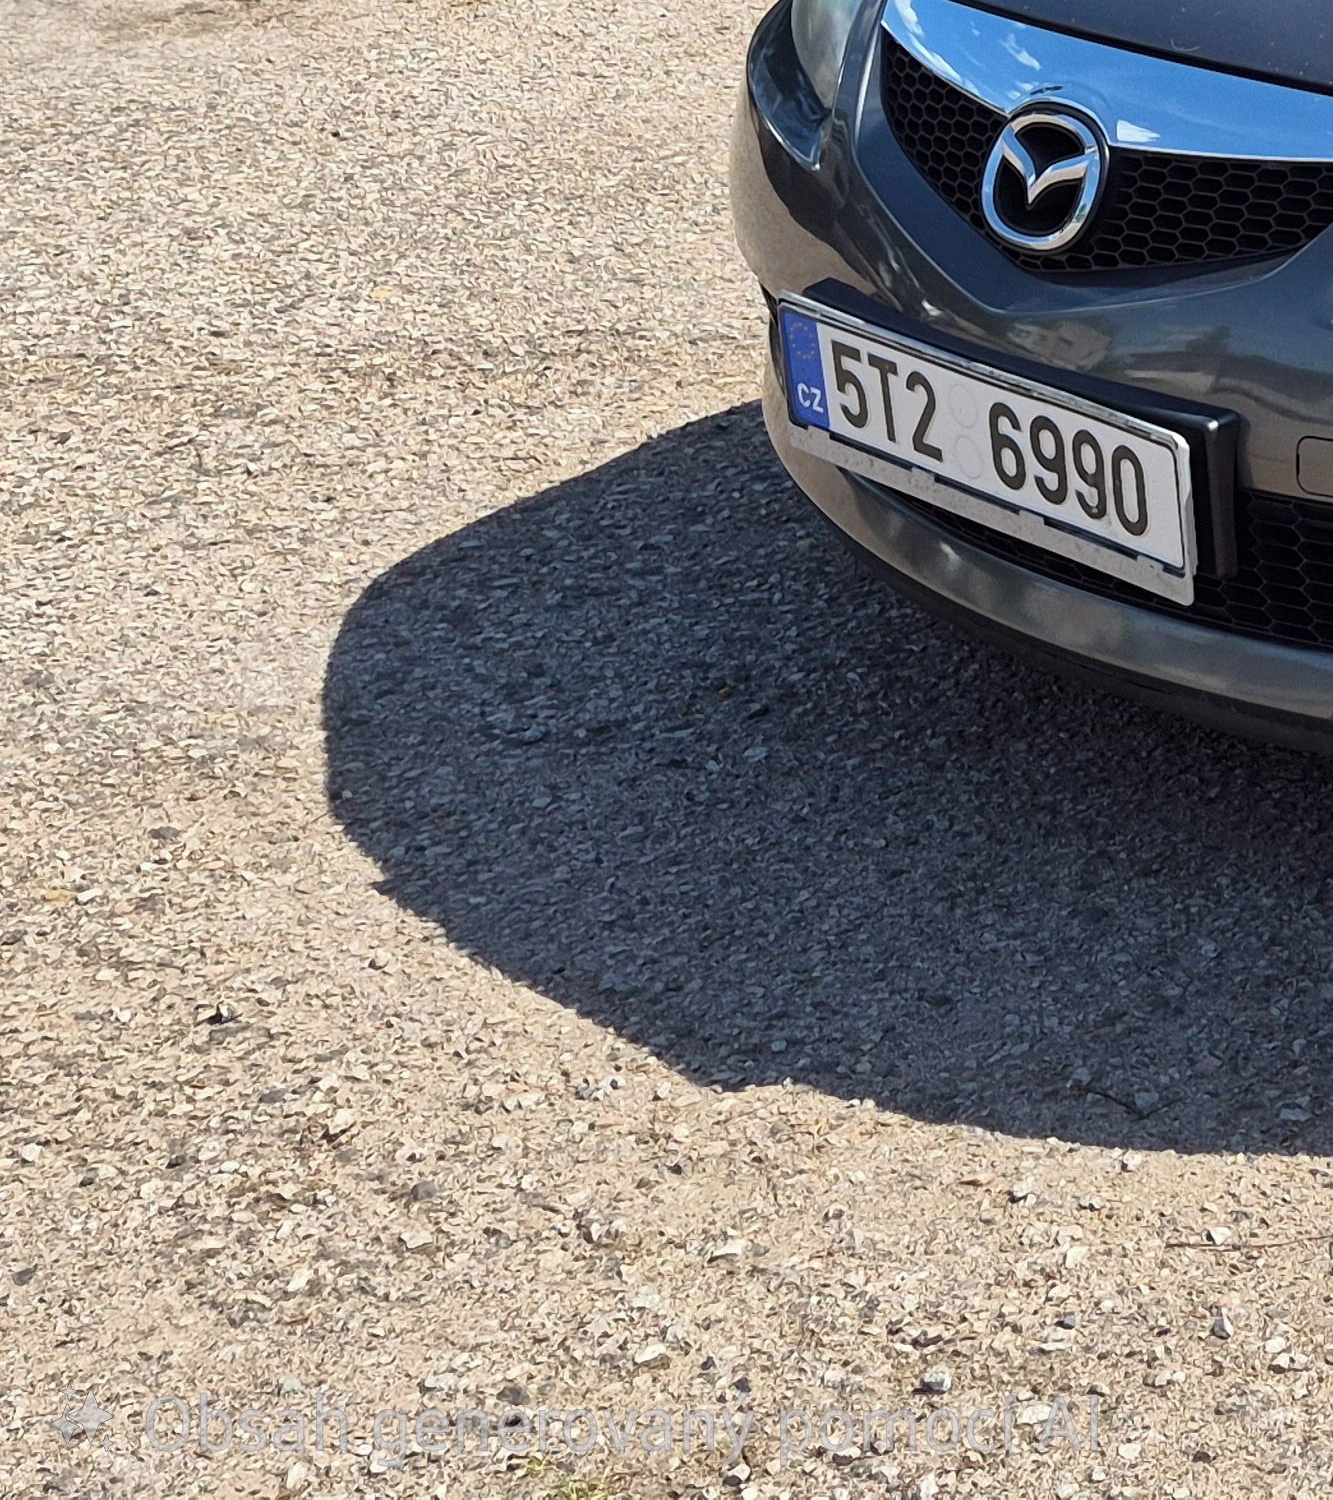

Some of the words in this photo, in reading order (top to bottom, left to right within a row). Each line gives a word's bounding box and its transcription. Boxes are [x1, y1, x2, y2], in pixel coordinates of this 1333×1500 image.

[796, 381, 825, 415] CZ
[831, 339, 943, 463] 5T2
[988, 402, 1148, 536] 6990
